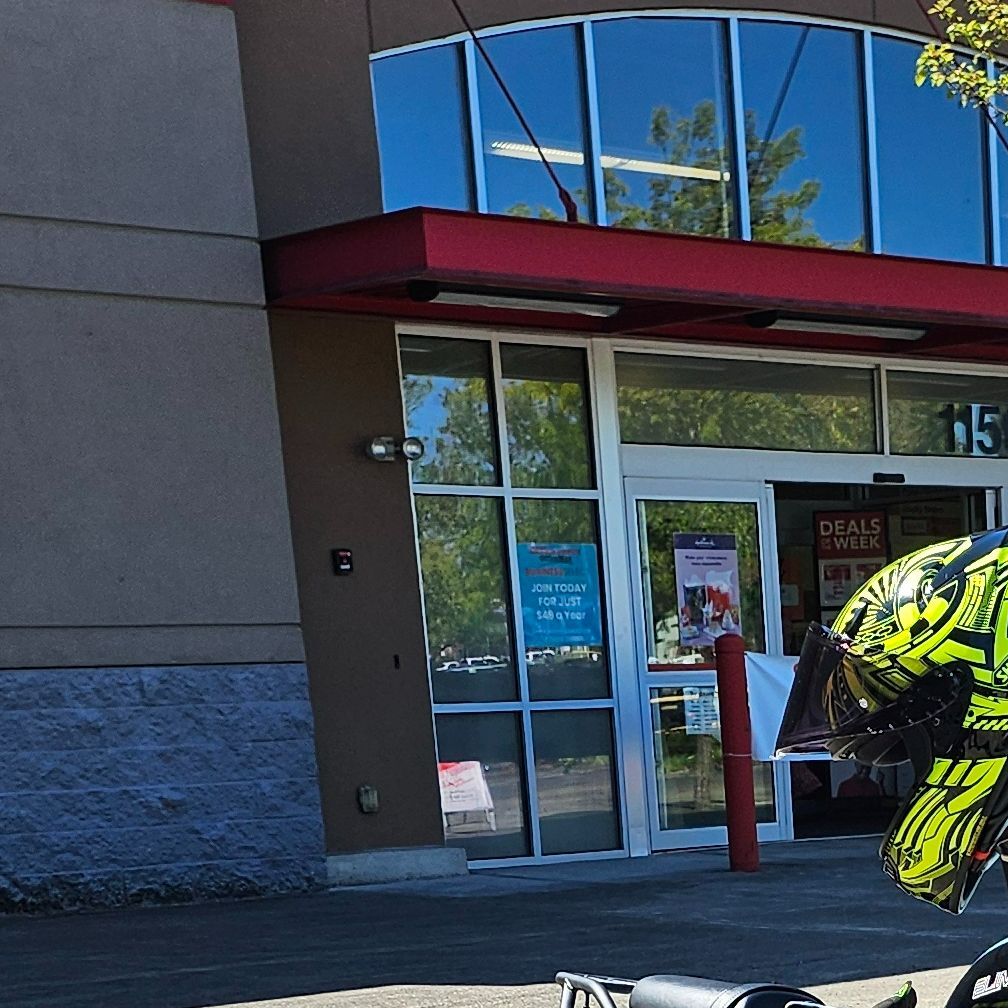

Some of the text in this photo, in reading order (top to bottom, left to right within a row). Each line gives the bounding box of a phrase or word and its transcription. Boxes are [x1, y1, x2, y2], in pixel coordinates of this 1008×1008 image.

[819, 518, 882, 536] DEALS
[833, 535, 881, 550] WEEK
[531, 583, 588, 593] JOIN TODAY
[538, 597, 582, 606] FOR JUST
